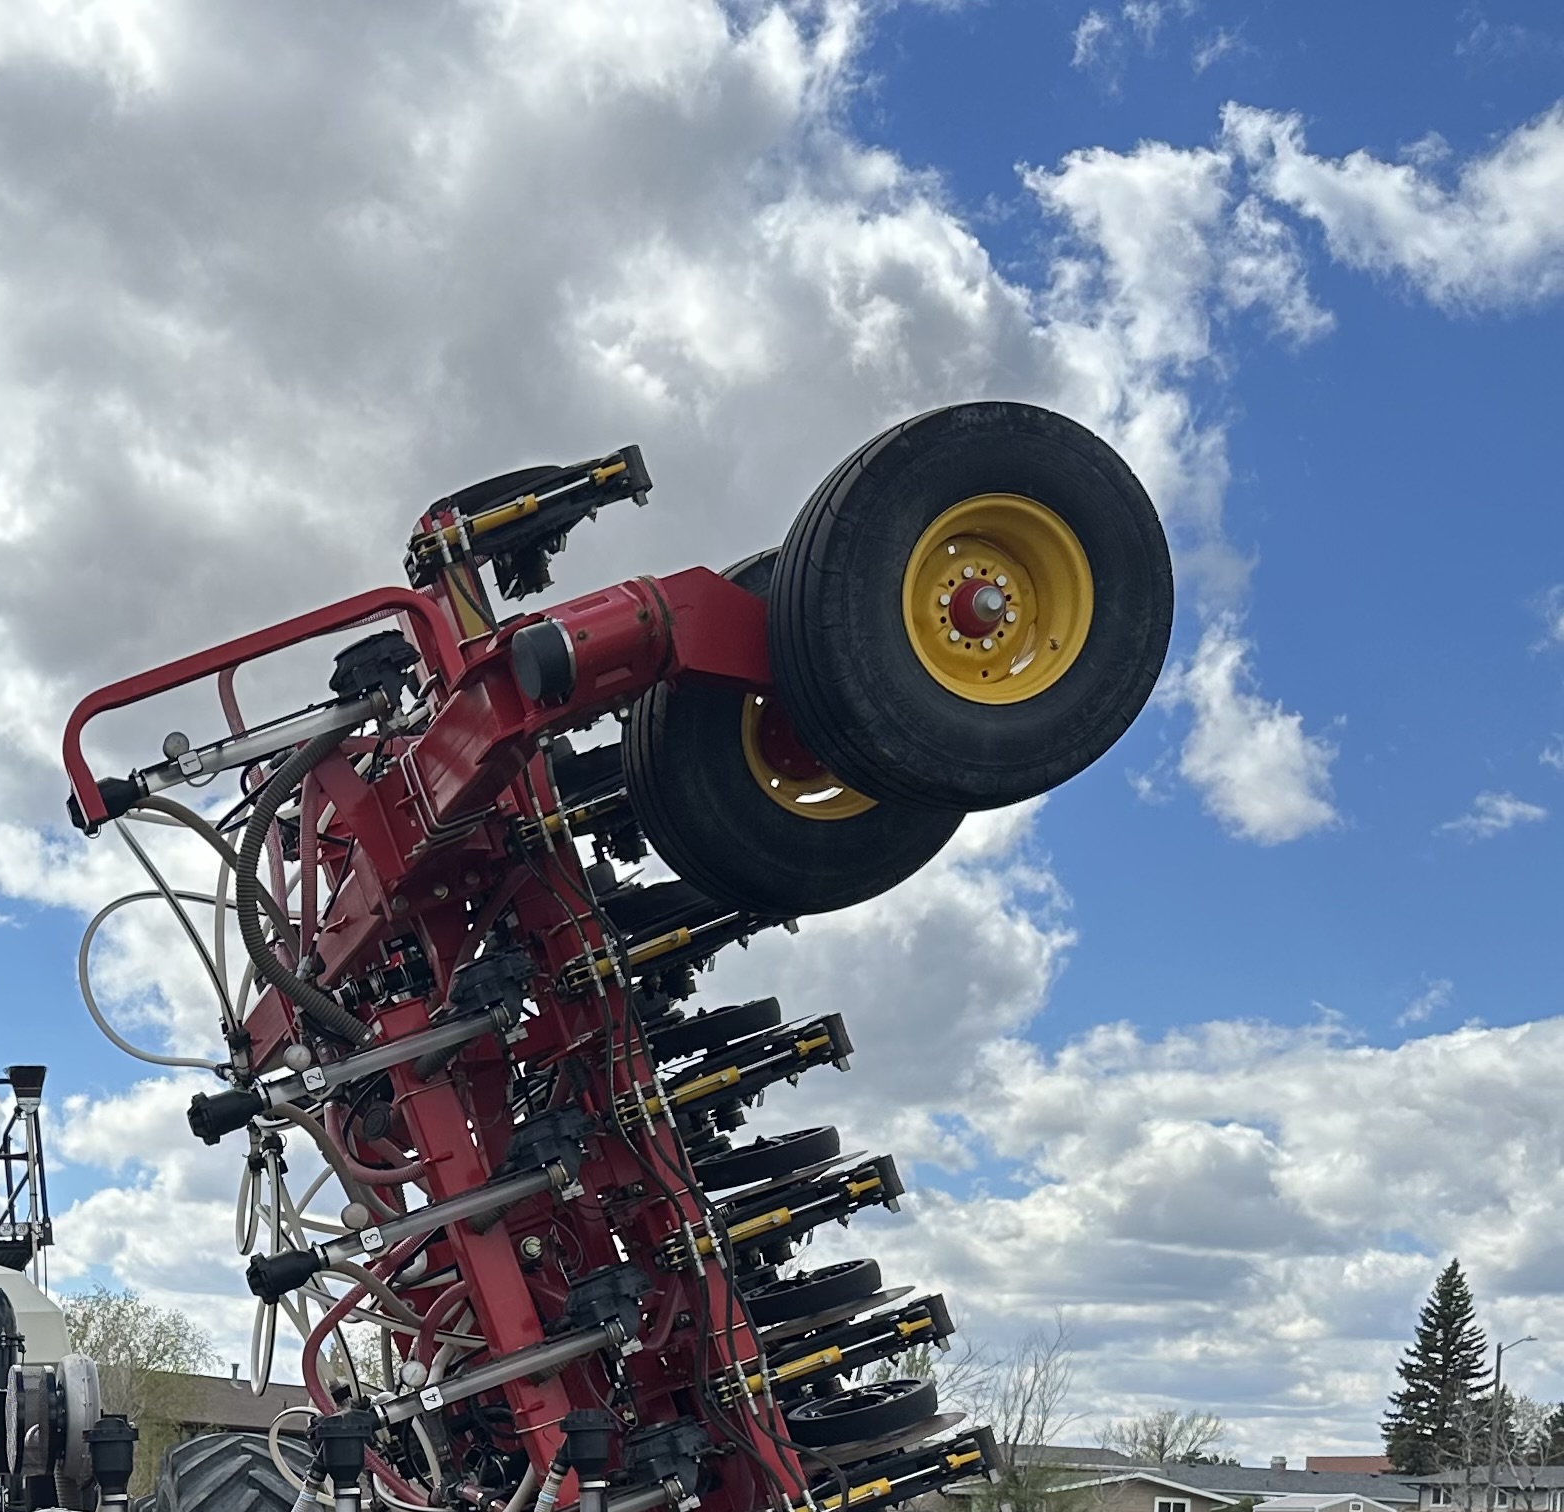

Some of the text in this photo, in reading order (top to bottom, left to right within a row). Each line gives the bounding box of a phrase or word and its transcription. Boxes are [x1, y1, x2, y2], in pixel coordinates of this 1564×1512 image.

[184, 757, 197, 767] 1
[307, 1073, 322, 1085] 2
[365, 1233, 379, 1245] 3
[425, 1392, 438, 1402] 4
